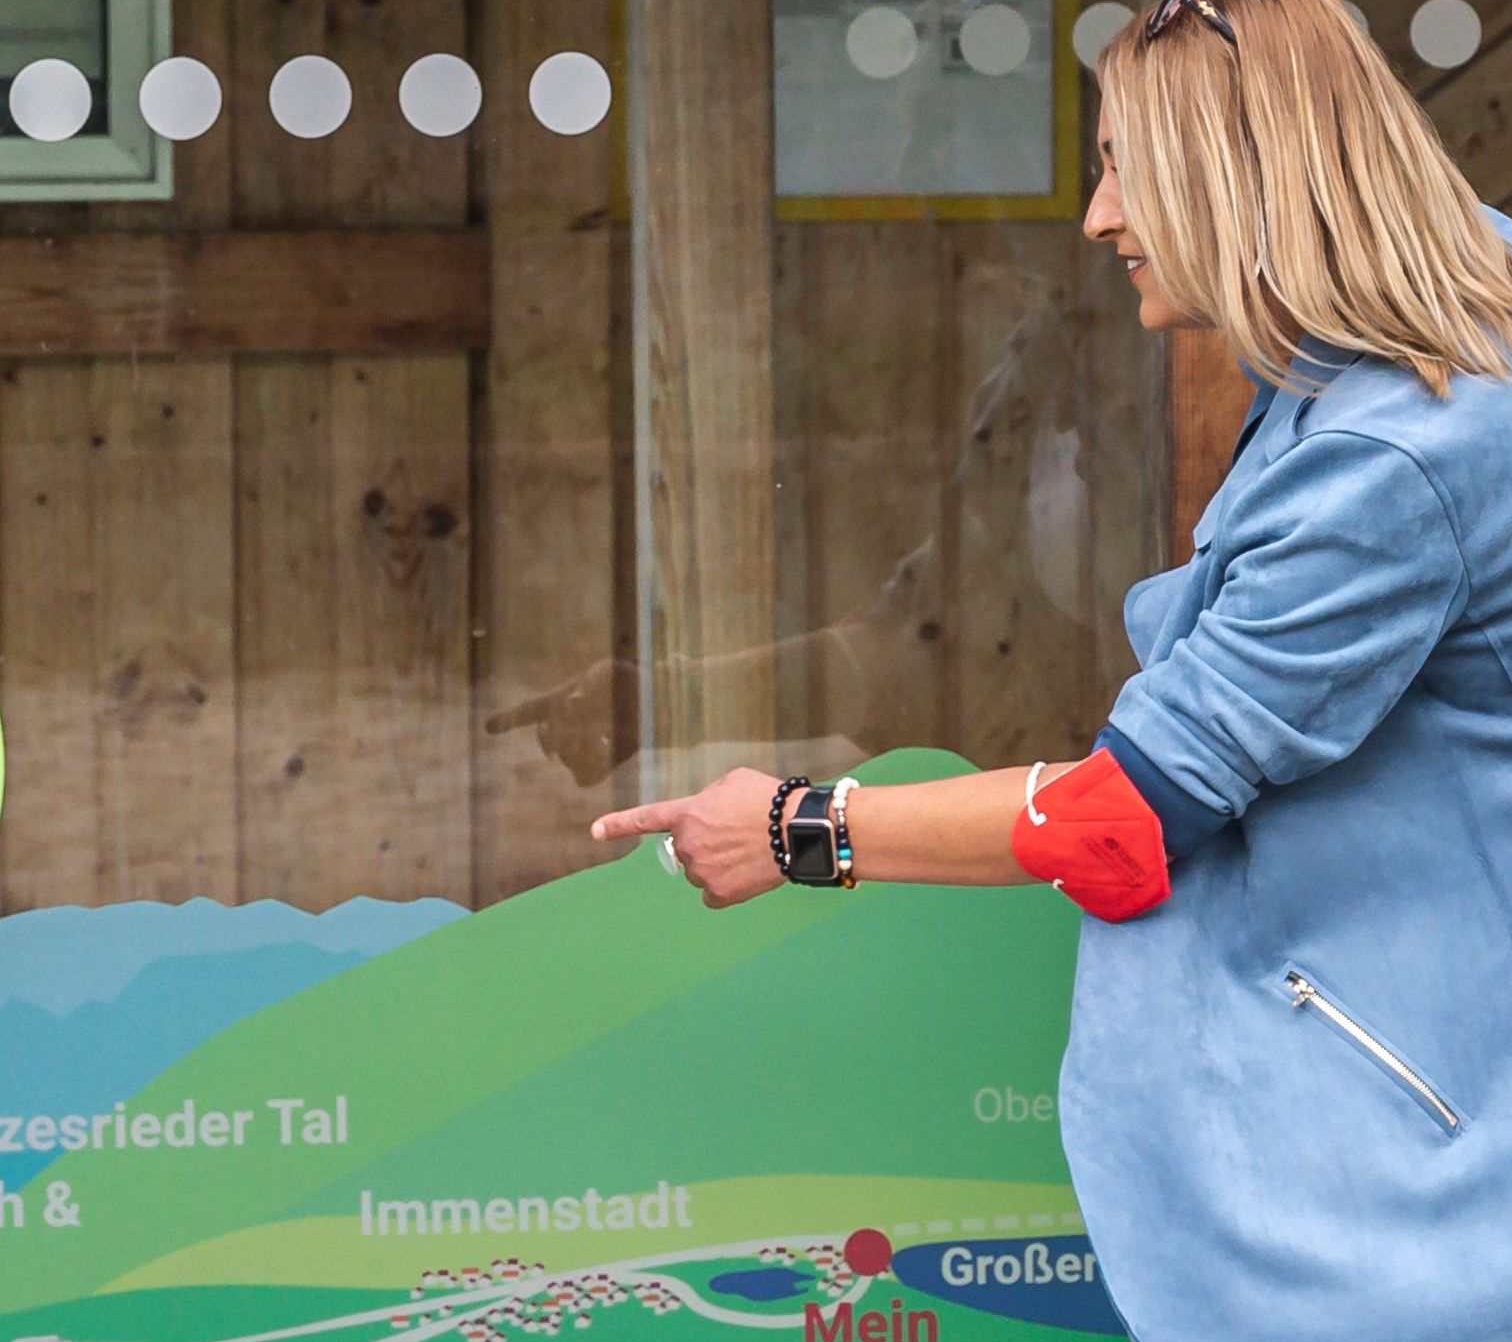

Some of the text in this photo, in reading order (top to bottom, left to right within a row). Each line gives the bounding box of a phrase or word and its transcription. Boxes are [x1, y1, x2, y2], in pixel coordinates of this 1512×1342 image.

[267, 1096, 349, 1146] Tal
[42, 1181, 82, 1228] &
[360, 1181, 694, 1237] Immenstadt
